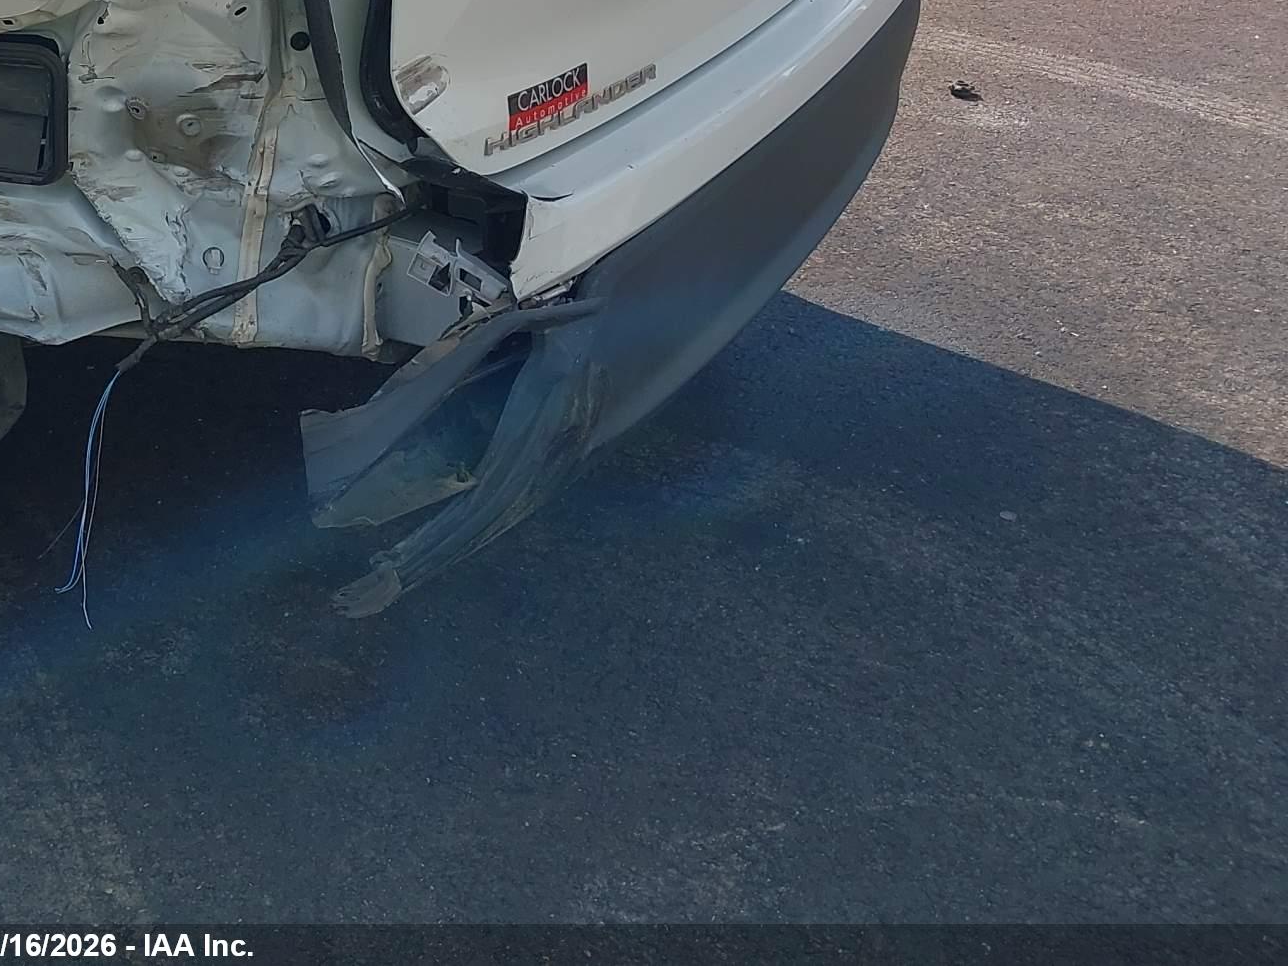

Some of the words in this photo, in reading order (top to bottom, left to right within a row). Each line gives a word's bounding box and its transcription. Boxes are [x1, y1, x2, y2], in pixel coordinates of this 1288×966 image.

[484, 64, 656, 156] HIGHLANDER
[515, 90, 586, 128] Automotive
[517, 68, 580, 111] CARLOCK
